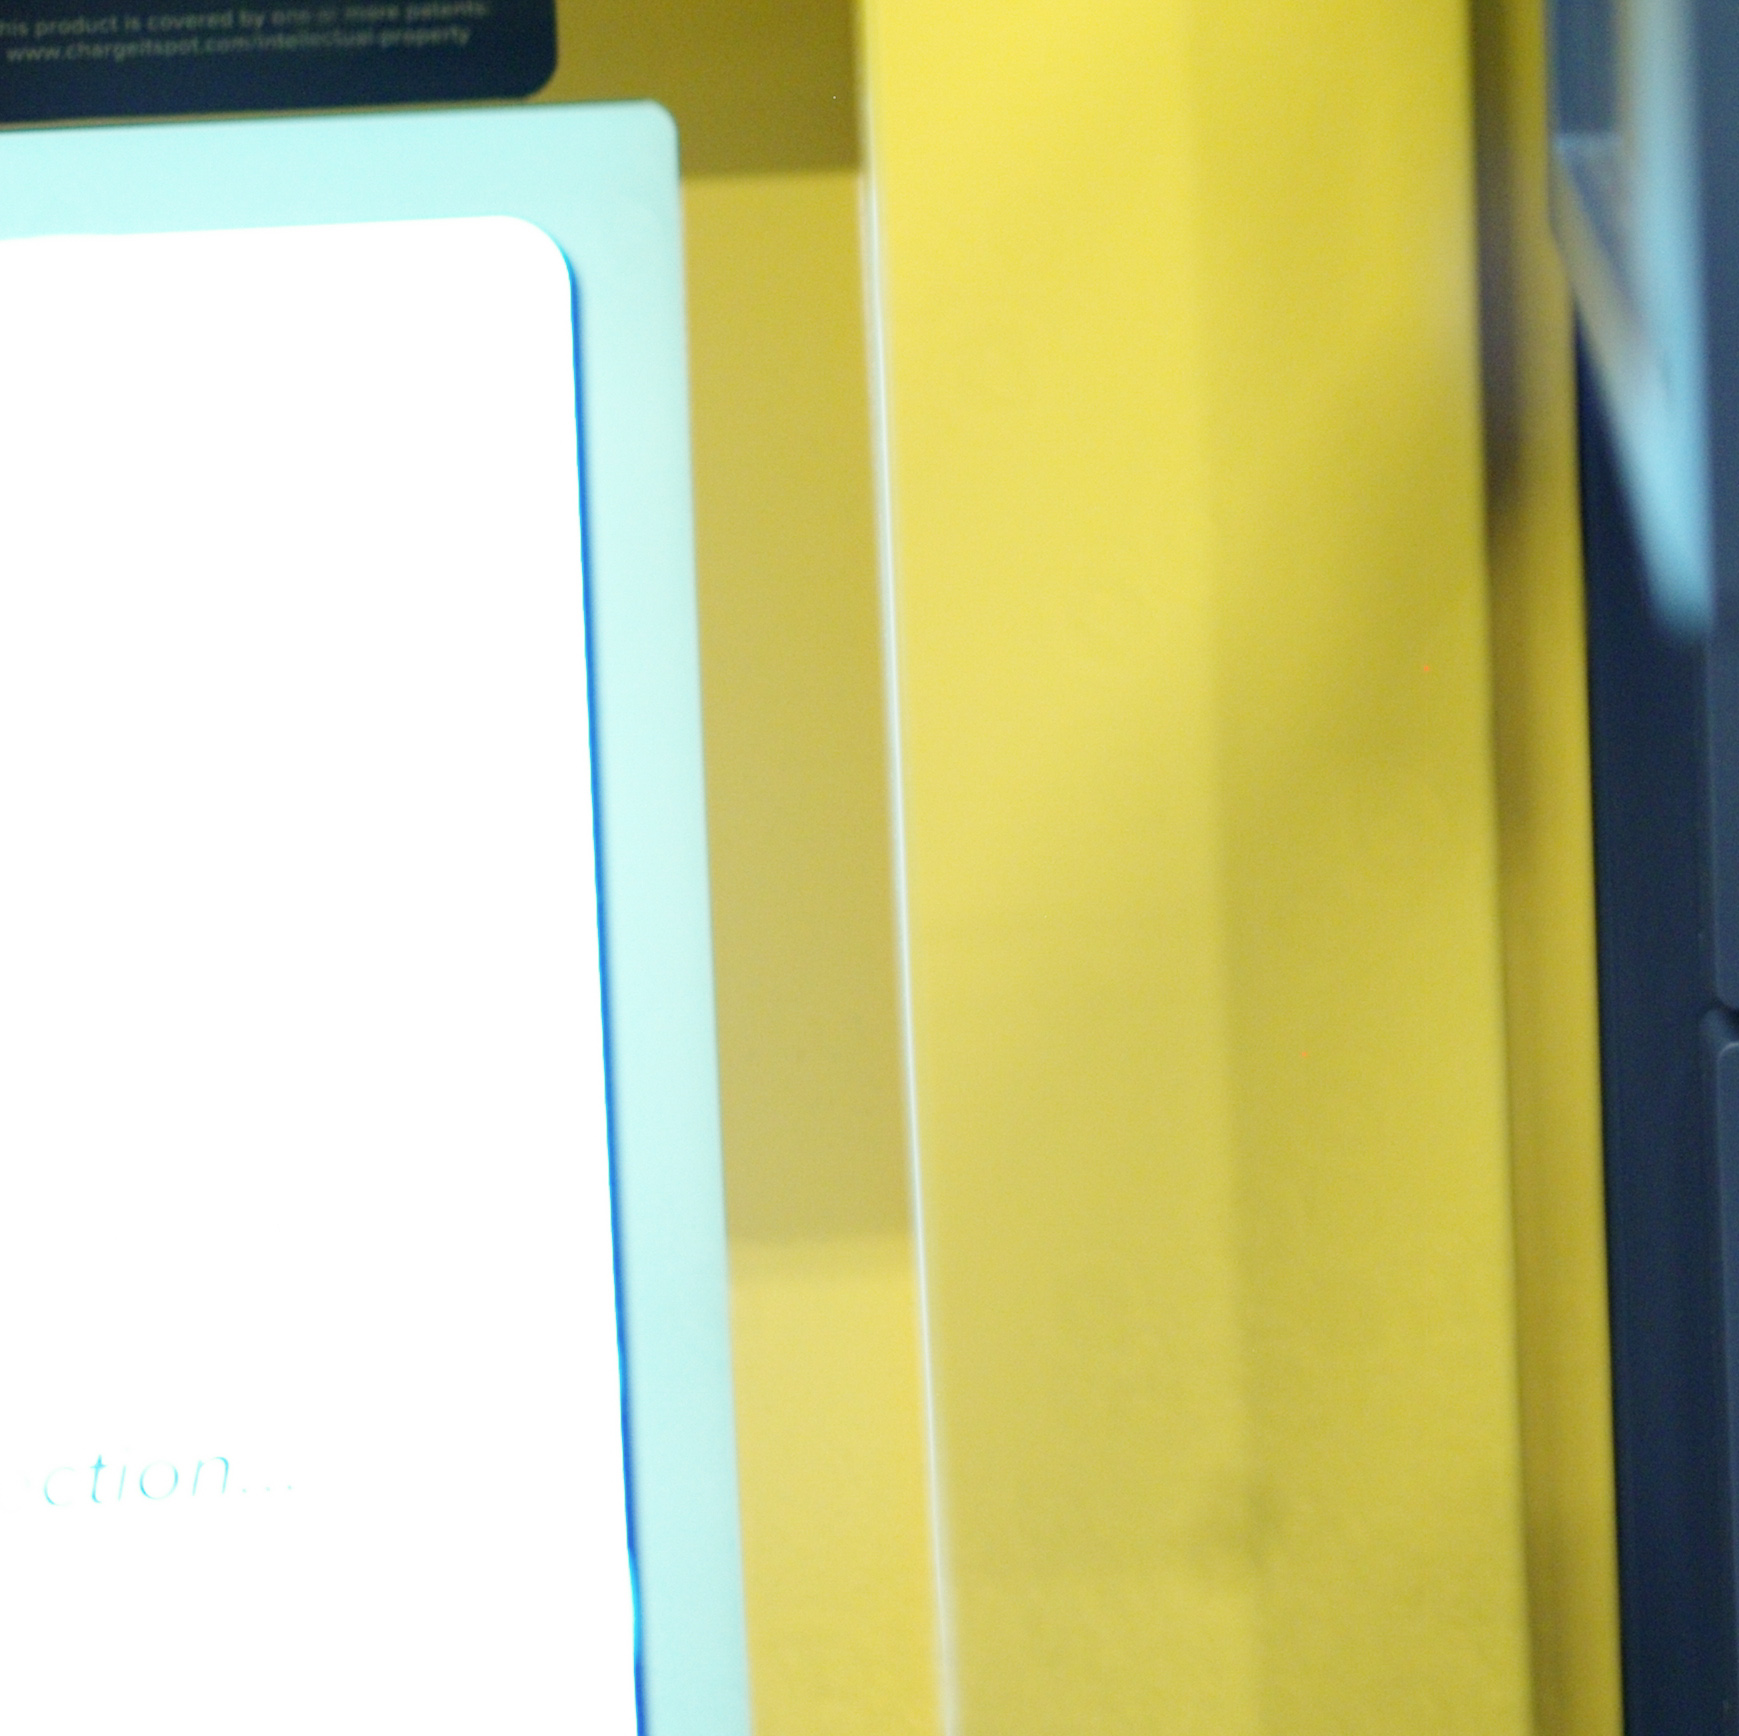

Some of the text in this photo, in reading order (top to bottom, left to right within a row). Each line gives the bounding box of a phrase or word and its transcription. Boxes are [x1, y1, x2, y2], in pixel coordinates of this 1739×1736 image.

[34, 17, 117, 40] product
[147, 10, 234, 31] covered
[41, 1453, 294, 1506] ction...
